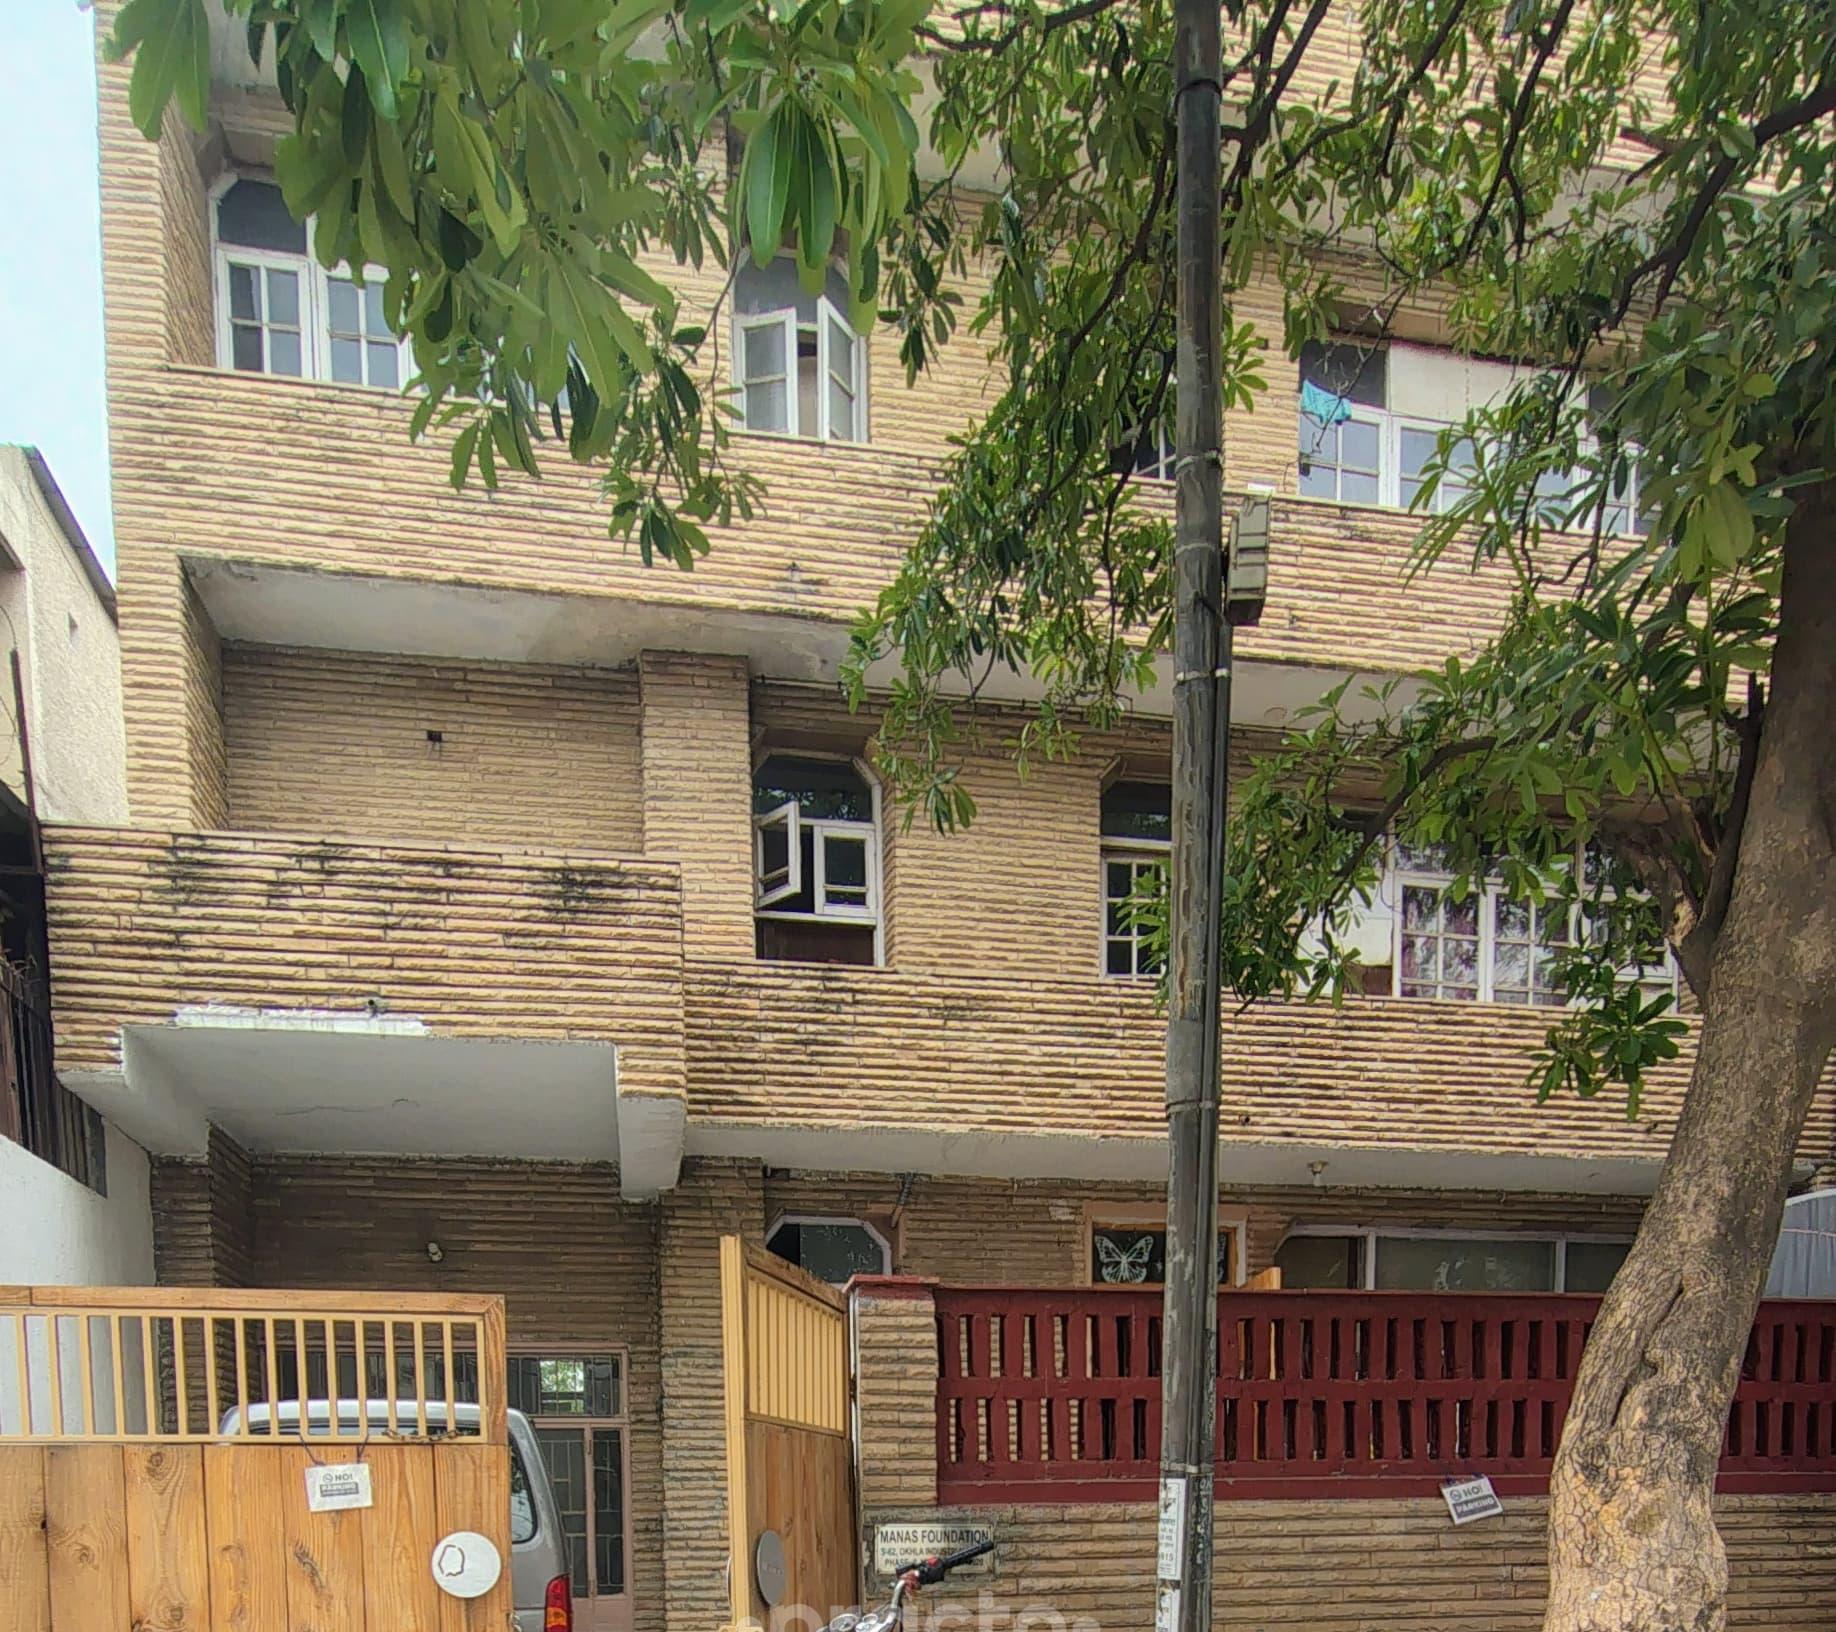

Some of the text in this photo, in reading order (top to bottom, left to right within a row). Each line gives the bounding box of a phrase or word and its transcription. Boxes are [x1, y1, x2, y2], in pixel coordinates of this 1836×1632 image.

[880, 1529, 989, 1543] MANAS FOUNDATION
[899, 1547, 924, 1556] OKHLA
